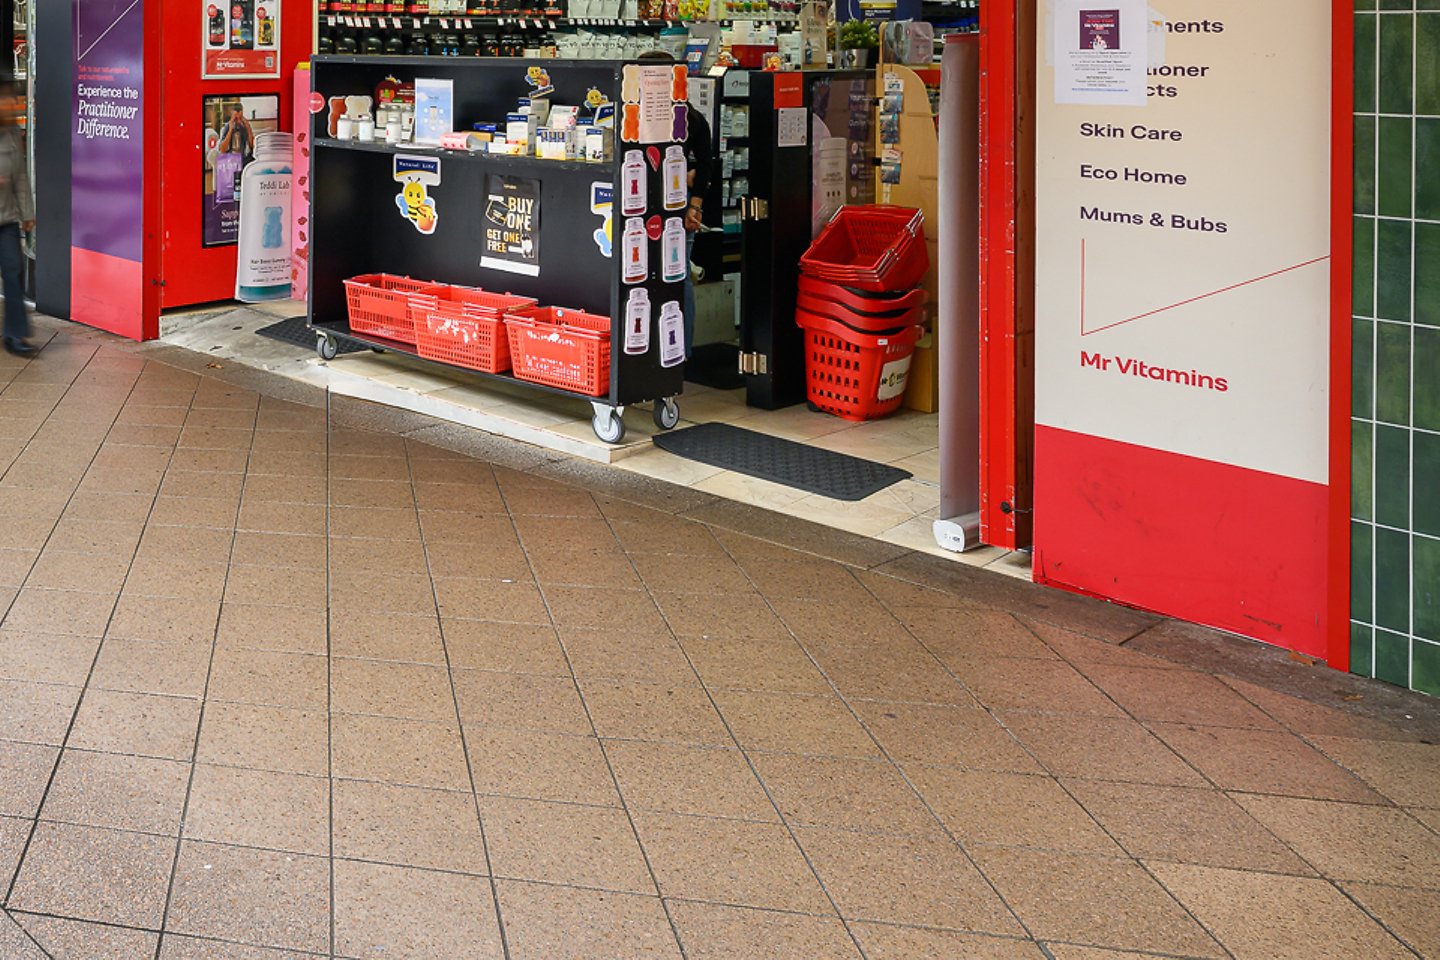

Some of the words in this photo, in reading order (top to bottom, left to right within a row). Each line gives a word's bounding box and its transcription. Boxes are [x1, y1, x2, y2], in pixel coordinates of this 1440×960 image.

[77, 83, 122, 99] Experience
[123, 86, 139, 100] the
[77, 99, 138, 120] Practitioner
[77, 118, 130, 140] Difference.
[1080, 122, 1125, 139] Skin
[1130, 125, 1183, 141] Care
[1080, 164, 1118, 181] Eco
[1123, 167, 1188, 186] Home
[259, 181, 278, 191] Teddi
[278, 180, 290, 190] Lab
[507, 196, 534, 215] BUY
[506, 212, 532, 232] ONE
[1080, 206, 1144, 226] Mums
[1149, 212, 1165, 228] &
[1171, 214, 1228, 234] Bubs
[486, 228, 502, 240] GET
[503, 231, 521, 244] ONE
[487, 240, 507, 253] FREE
[1080, 350, 1112, 372] Mr
[1115, 356, 1229, 393] Vitamins
